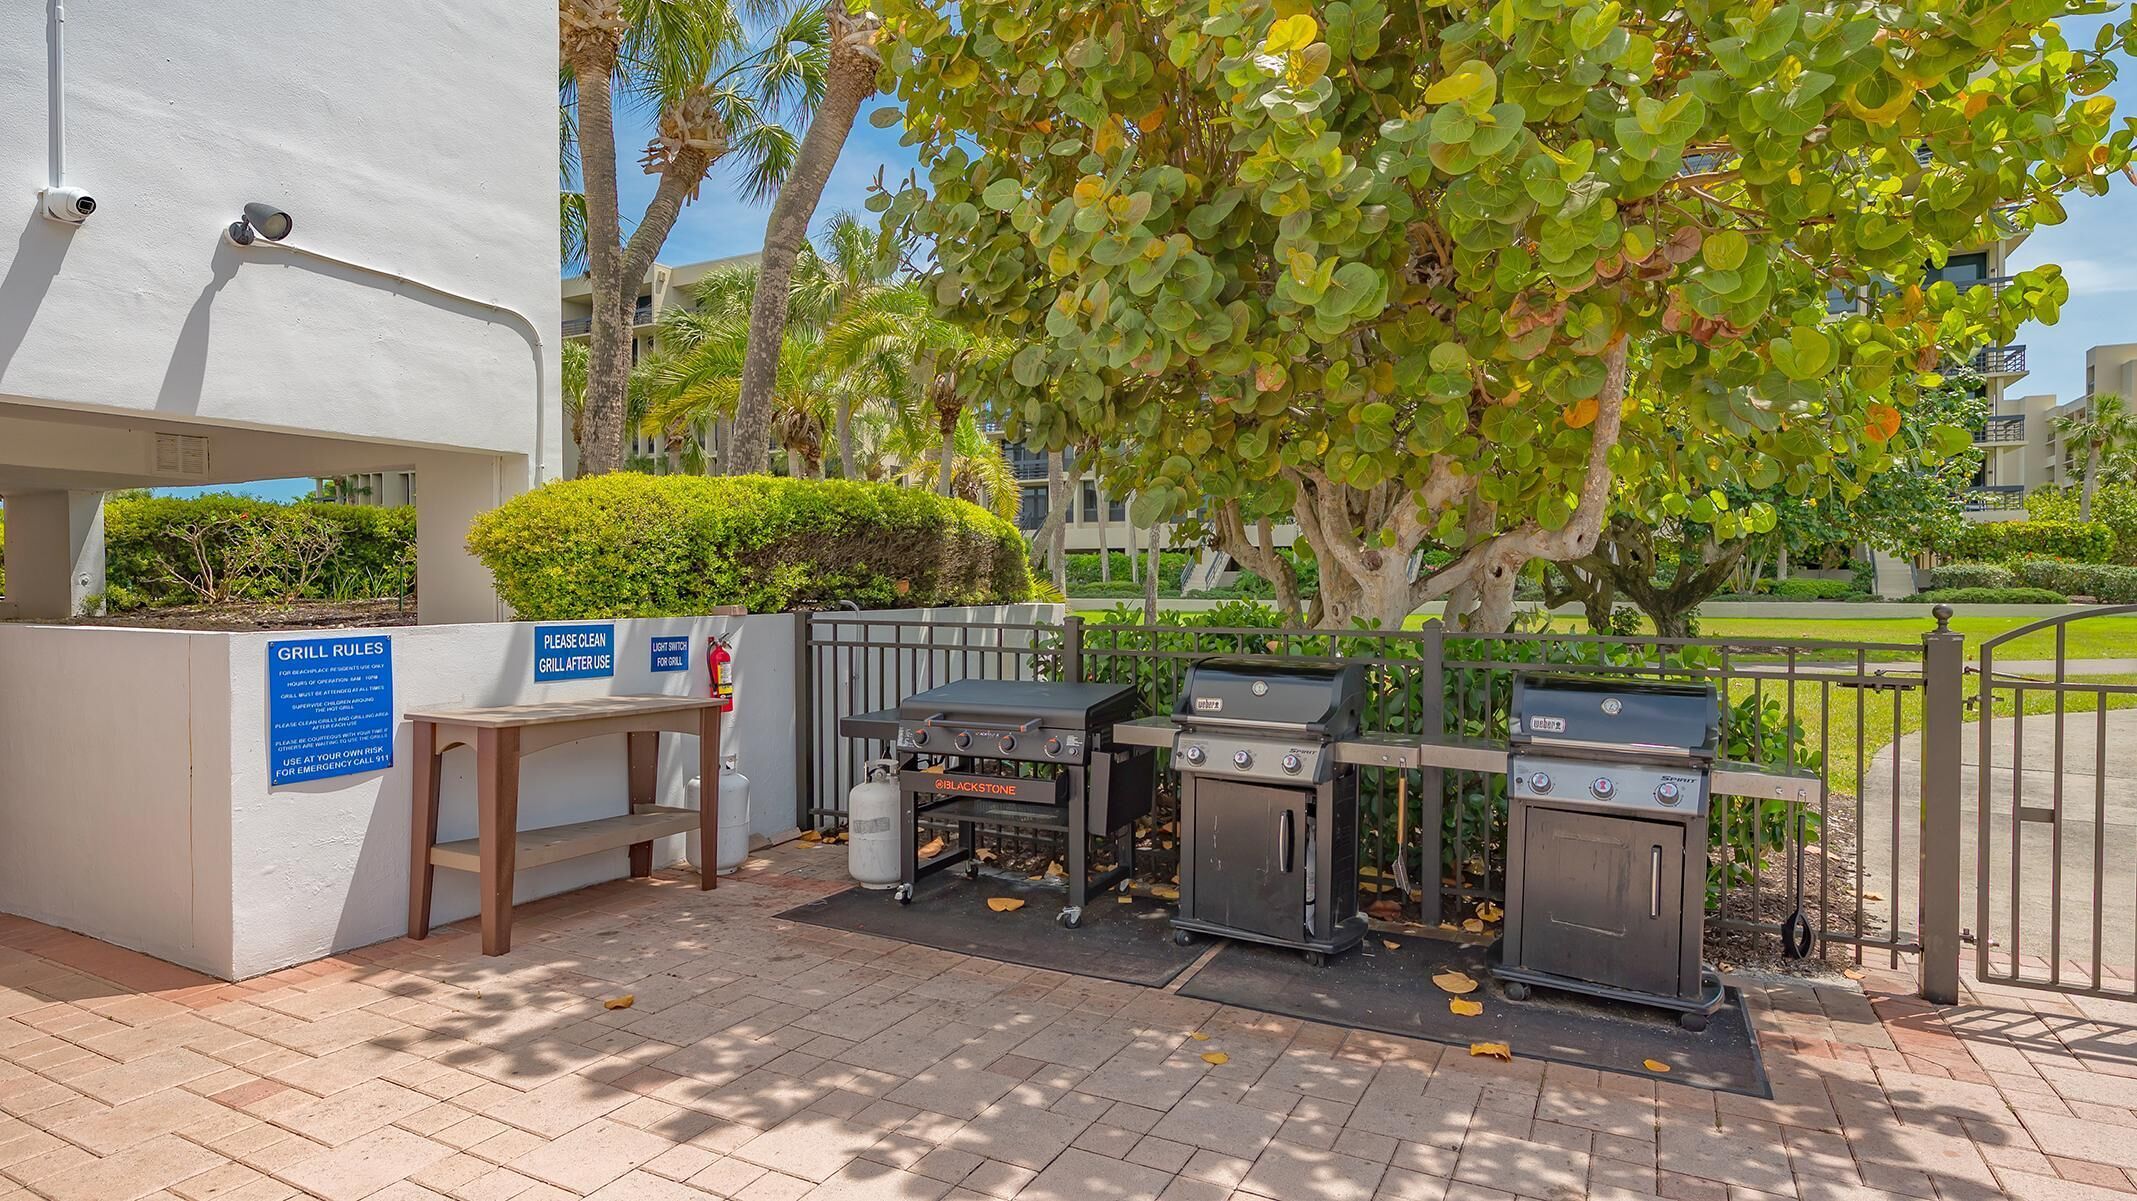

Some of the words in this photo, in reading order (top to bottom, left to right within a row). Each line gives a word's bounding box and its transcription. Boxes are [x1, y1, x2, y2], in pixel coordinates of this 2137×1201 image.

[544, 633, 577, 649] PLEASE
[579, 632, 606, 648] CLEAN
[652, 642, 668, 652] LIGHT
[668, 641, 687, 651] SWITCH
[278, 645, 328, 660] GRILL
[333, 642, 384, 657] RULES
[539, 657, 565, 673] GRILL
[566, 655, 593, 671] AFTER
[594, 654, 610, 669] USE
[657, 657, 668, 667] FOR
[668, 656, 683, 666] GRILL
[291, 702, 323, 710] SUPERVISE
[323, 699, 351, 707] CHILDREN
[1198, 698, 1214, 708] weber
[275, 721, 298, 729] PLEASE
[351, 712, 374, 720] GRILLING
[312, 723, 330, 731] AFTER
[1533, 717, 1556, 729] weber
[278, 743, 302, 752] OTHERS
[315, 739, 339, 747] WAITING
[283, 757, 302, 767] USE
[304, 755, 316, 764] AT
[317, 751, 342, 762] YOUR
[343, 749, 363, 758] OWN
[364, 745, 384, 755] RISK
[276, 767, 296, 778] FOR
[297, 761, 352, 774] EMERGENCY
[353, 756, 374, 766] CALL
[375, 754, 389, 763] 911
[943, 780, 1016, 795] BLACKSTONE
